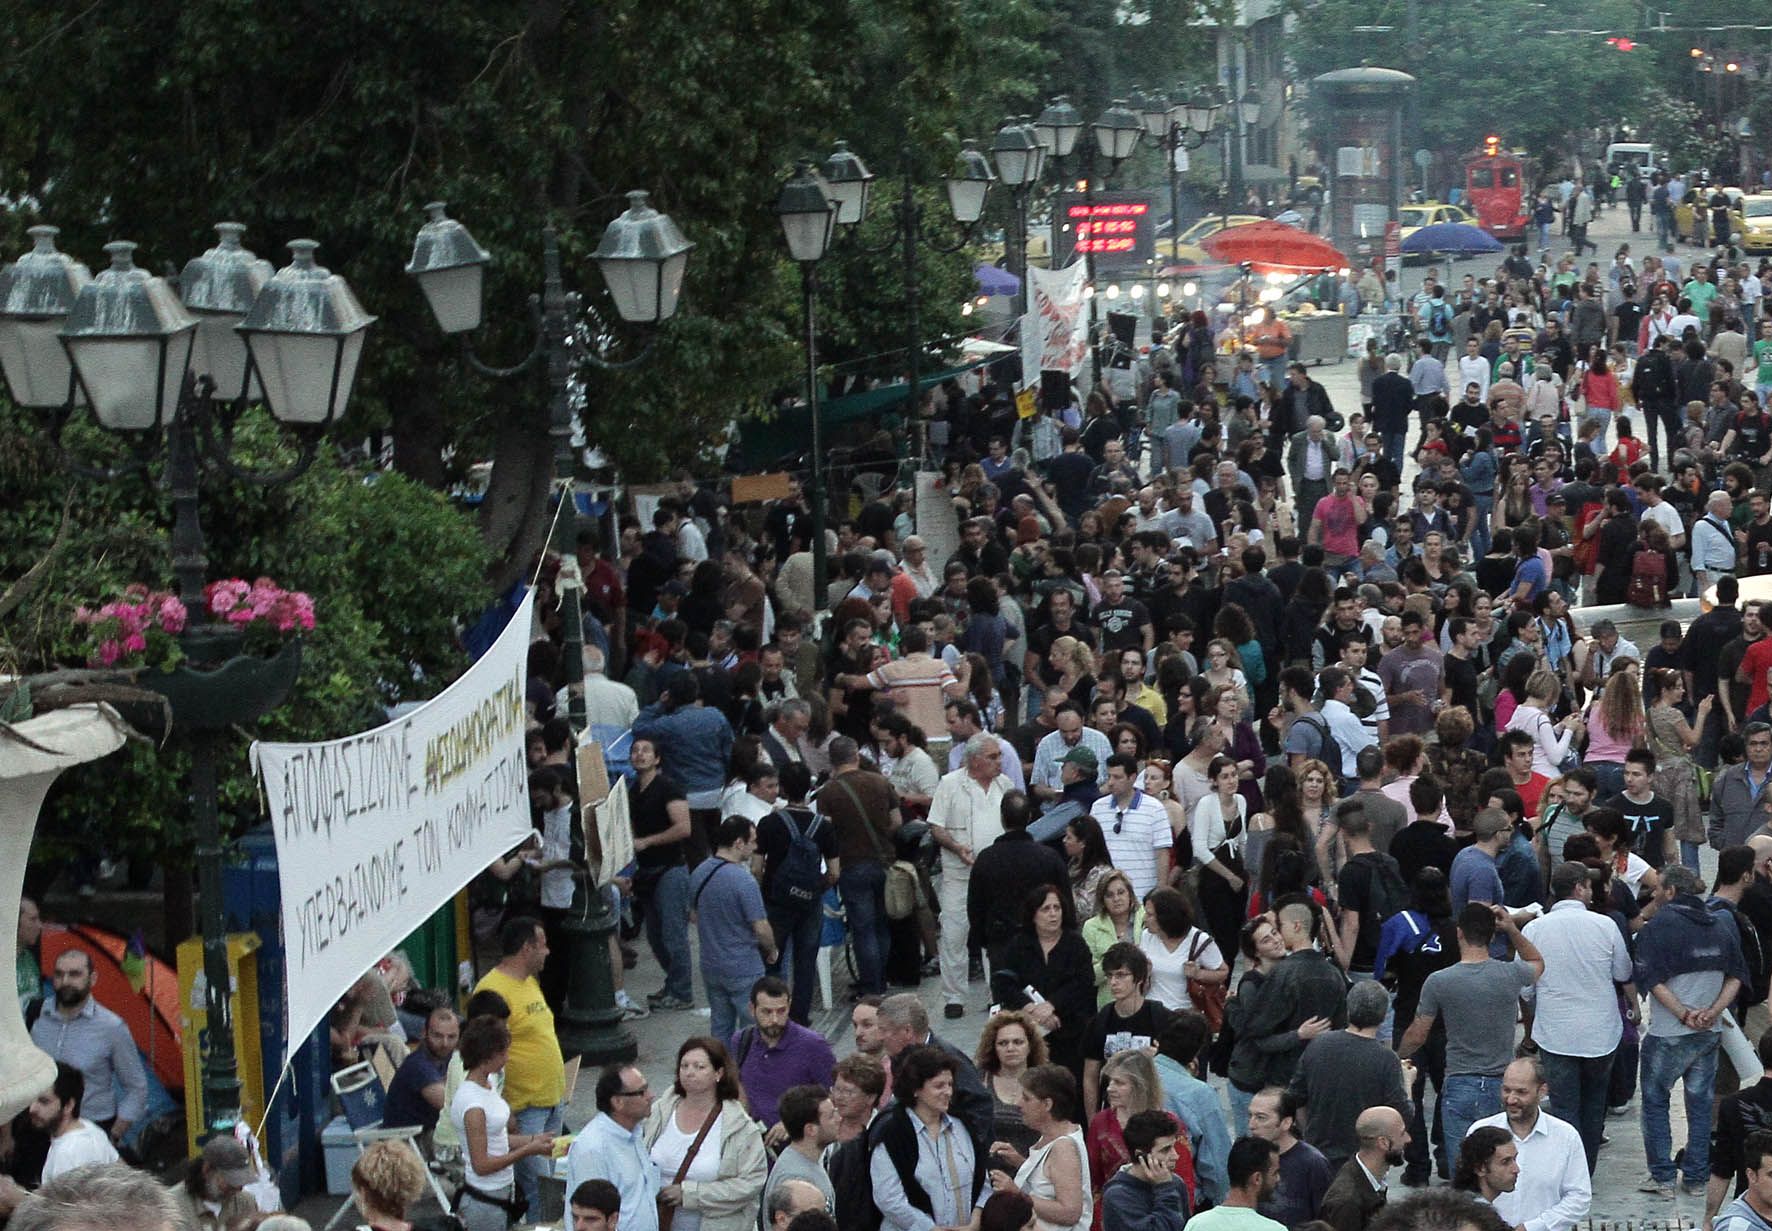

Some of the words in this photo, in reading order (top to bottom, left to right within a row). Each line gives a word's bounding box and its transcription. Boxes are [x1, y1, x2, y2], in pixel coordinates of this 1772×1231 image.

[282, 721, 418, 841] ΑΠΟΦΑΣΙΖΟΥΜΕ
[296, 840, 408, 969] ΥΠΕΡΒΑΙΝΟΥΜΕ
[413, 820, 442, 874] ΤΟΝ
